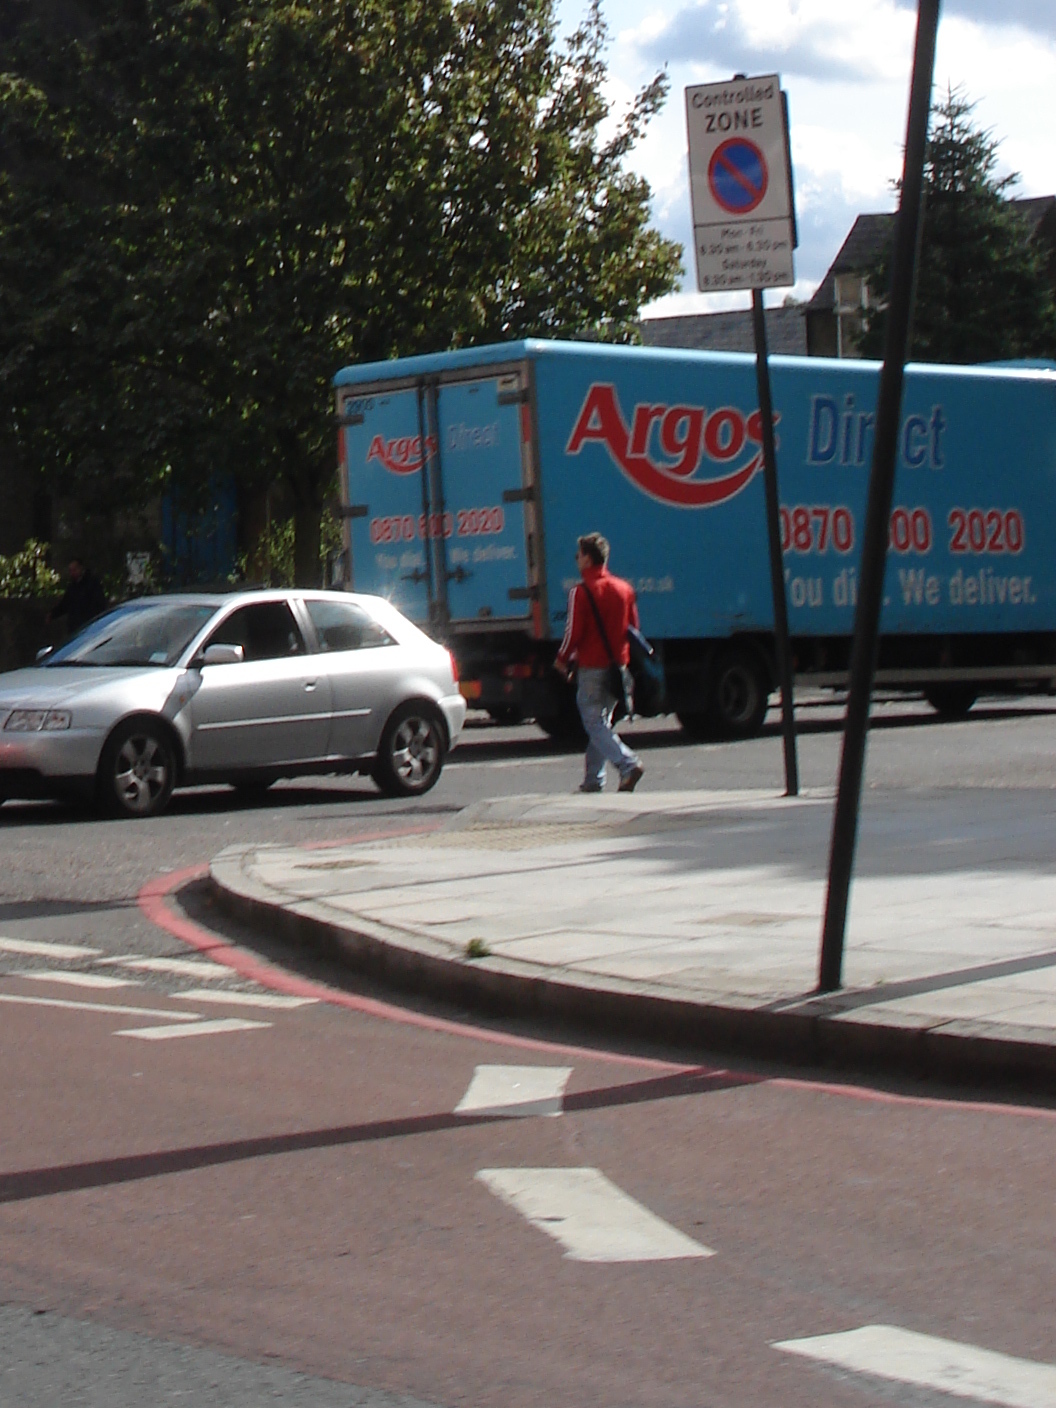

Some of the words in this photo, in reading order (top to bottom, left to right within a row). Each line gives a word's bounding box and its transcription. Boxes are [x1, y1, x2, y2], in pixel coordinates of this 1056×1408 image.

[693, 82, 774, 110] Controlled
[705, 107, 764, 133] ZONE
[366, 434, 438, 476] Argos
[446, 422, 501, 452] Direct
[565, 382, 782, 509] Argos
[807, 393, 946, 469] Dirct
[370, 514, 415, 544] 0870
[457, 505, 505, 537] 2020
[880, 505, 932, 554] 00
[948, 506, 1025, 554] 2020
[781, 568, 823, 607] ou
[899, 568, 941, 606] We
[949, 567, 1038, 607] deliver.
